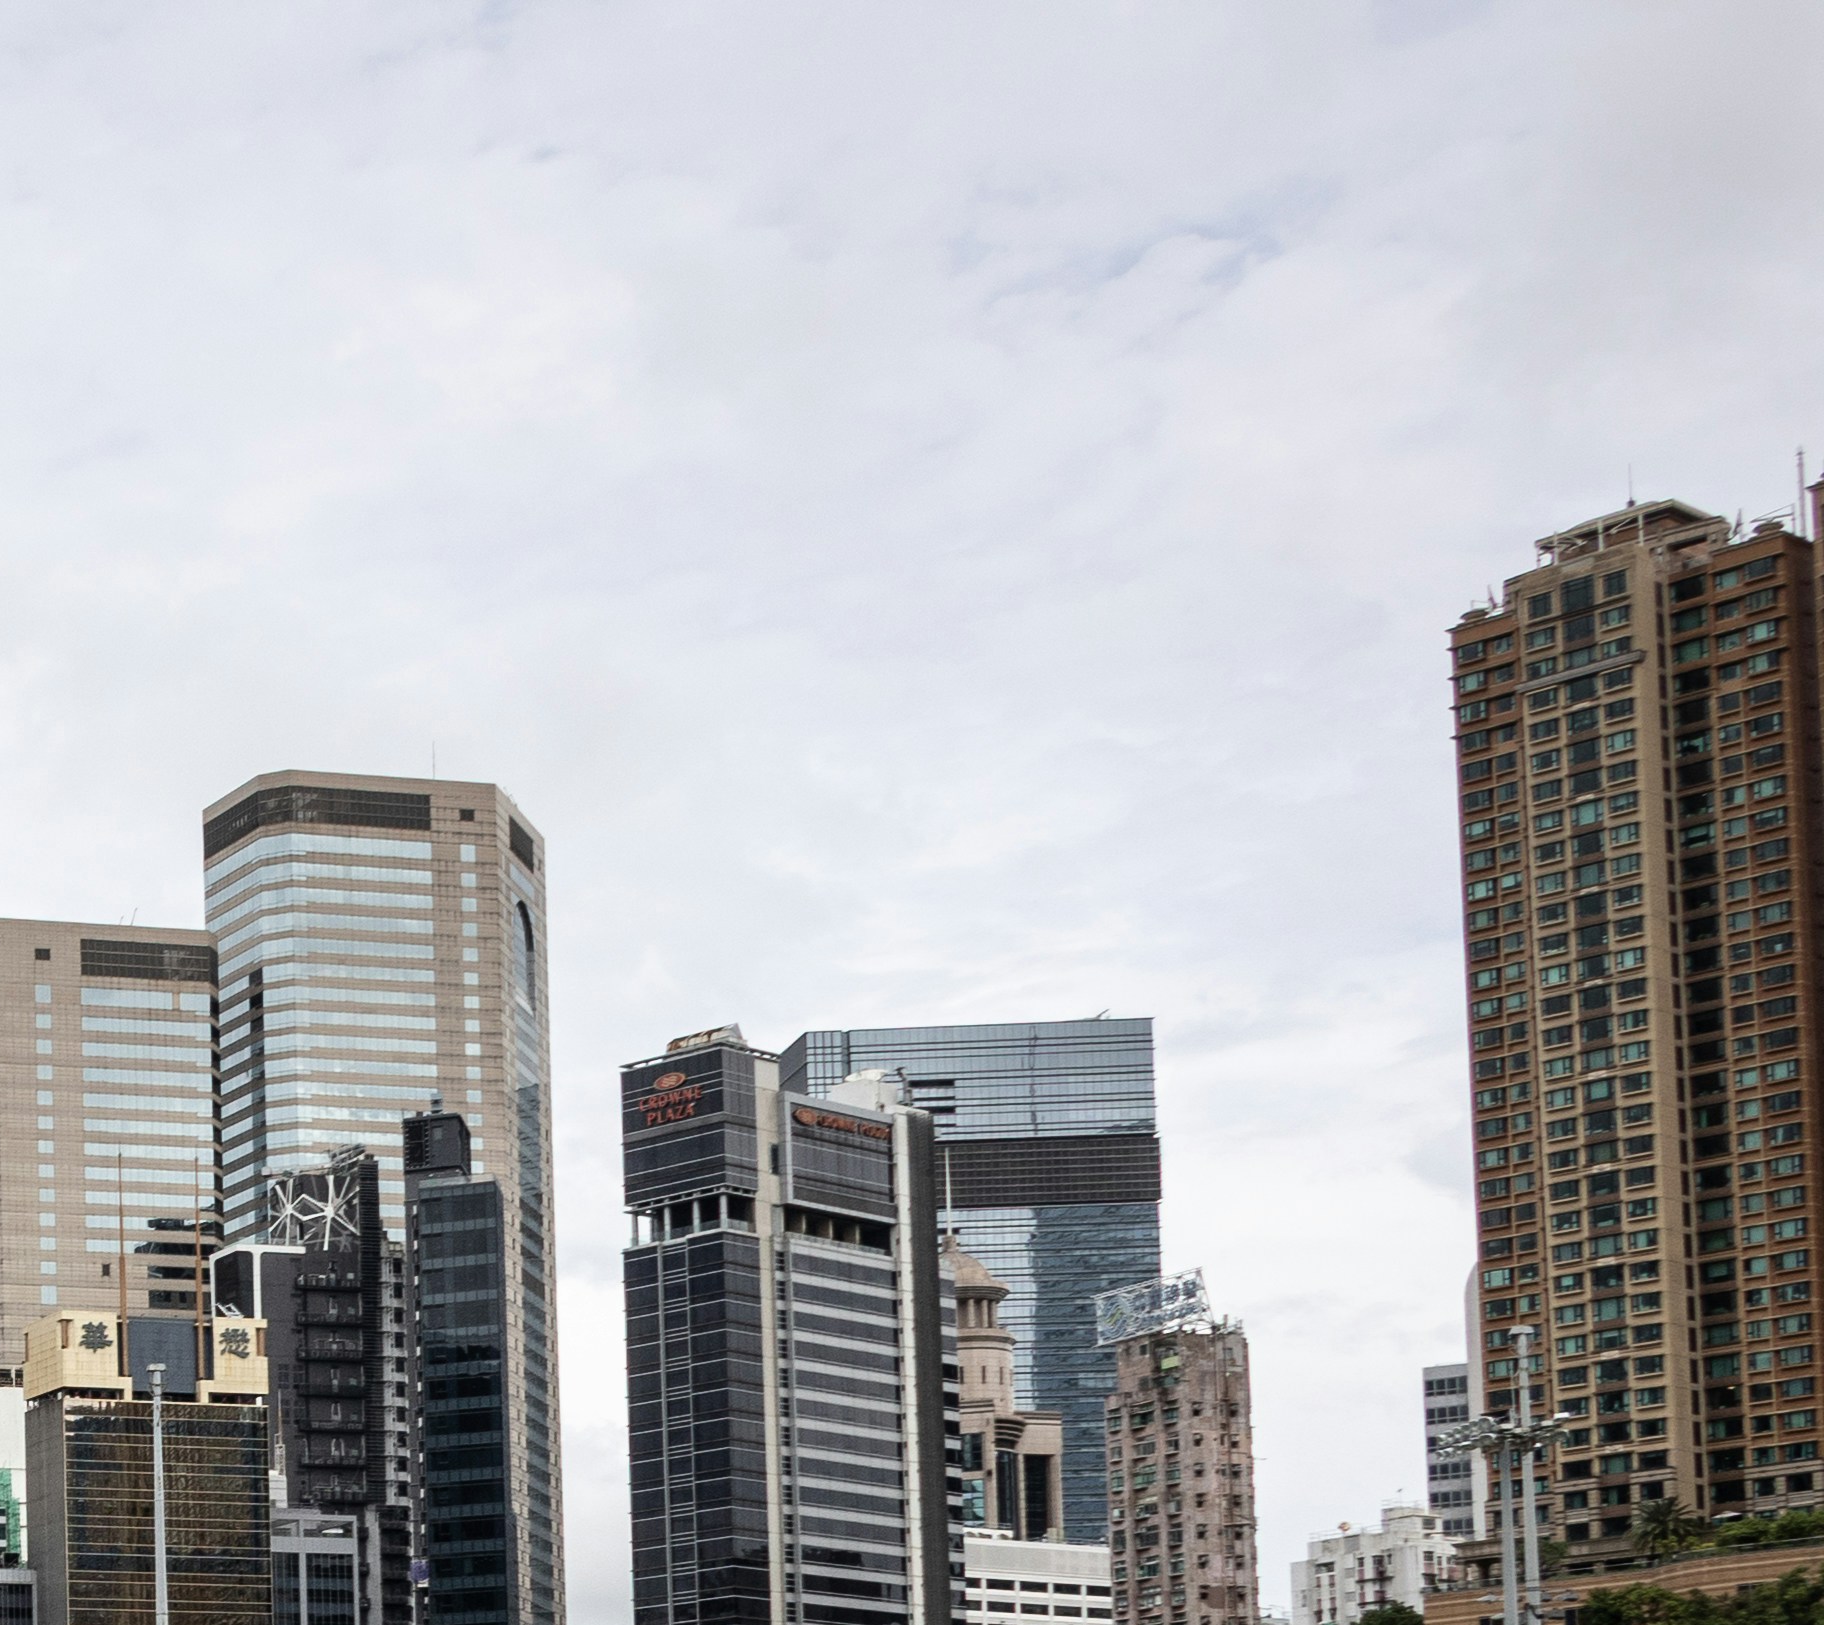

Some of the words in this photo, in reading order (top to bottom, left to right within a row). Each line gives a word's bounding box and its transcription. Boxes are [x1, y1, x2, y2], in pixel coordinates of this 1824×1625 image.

[640, 1085, 702, 1112] CROWNE
[647, 1103, 695, 1126] PLAZA
[79, 1321, 114, 1353] 華
